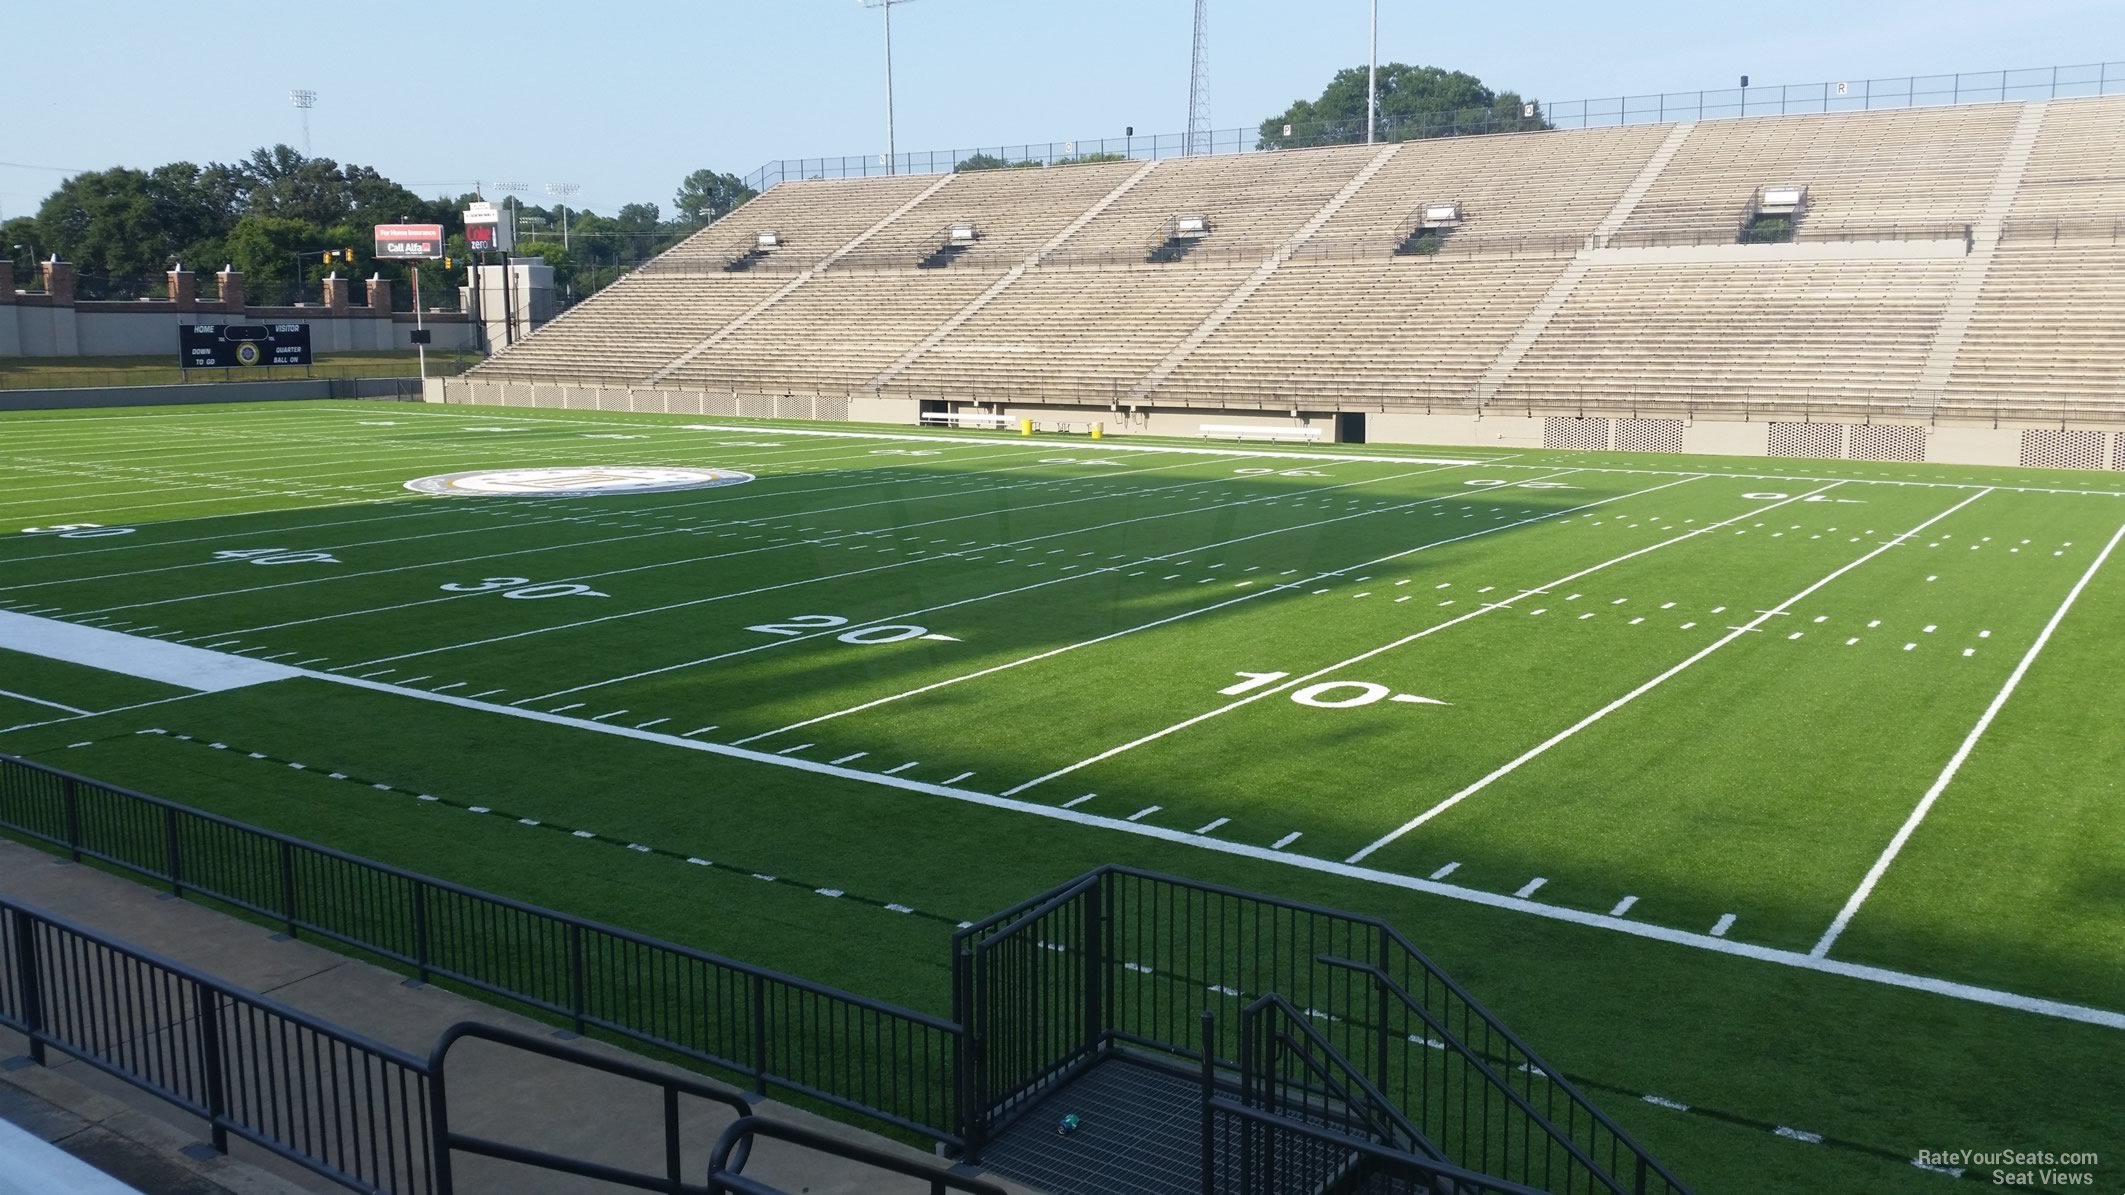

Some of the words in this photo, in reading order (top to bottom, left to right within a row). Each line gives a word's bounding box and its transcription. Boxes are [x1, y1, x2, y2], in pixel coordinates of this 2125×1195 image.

[466, 223, 491, 241] Coke
[387, 242, 404, 252] Call
[404, 242, 422, 252] Alfa
[471, 240, 488, 249] zero
[194, 325, 215, 333] HOME
[275, 324, 300, 332] VISITOR
[21, 523, 136, 538] 50
[212, 548, 333, 565] 40
[439, 577, 590, 599] 30
[743, 614, 928, 644] 20
[1217, 671, 1391, 708] 10
